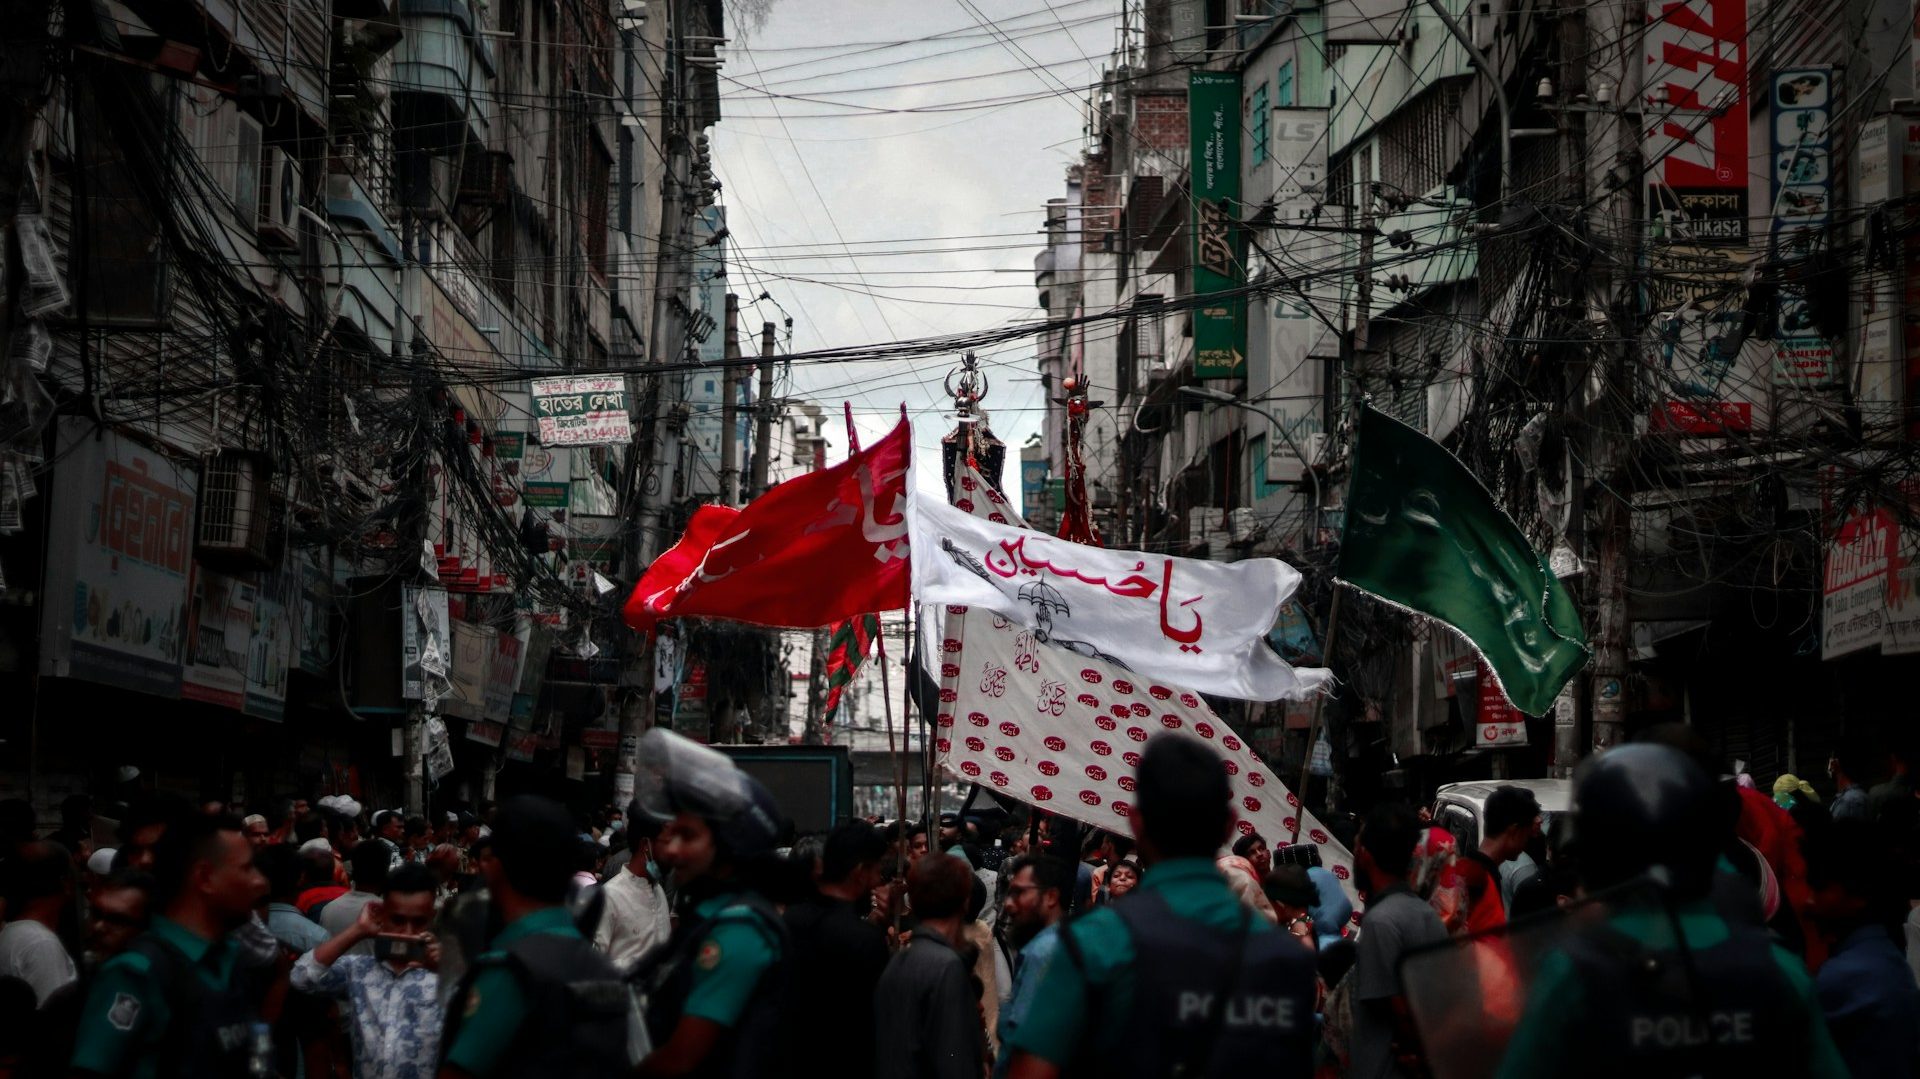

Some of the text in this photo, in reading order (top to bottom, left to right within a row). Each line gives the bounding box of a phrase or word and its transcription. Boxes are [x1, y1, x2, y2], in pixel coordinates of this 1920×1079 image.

[1277, 122, 1315, 141] LS
[1680, 194, 1740, 208] রুকাসা
[537, 391, 624, 415] হাতের লেখা
